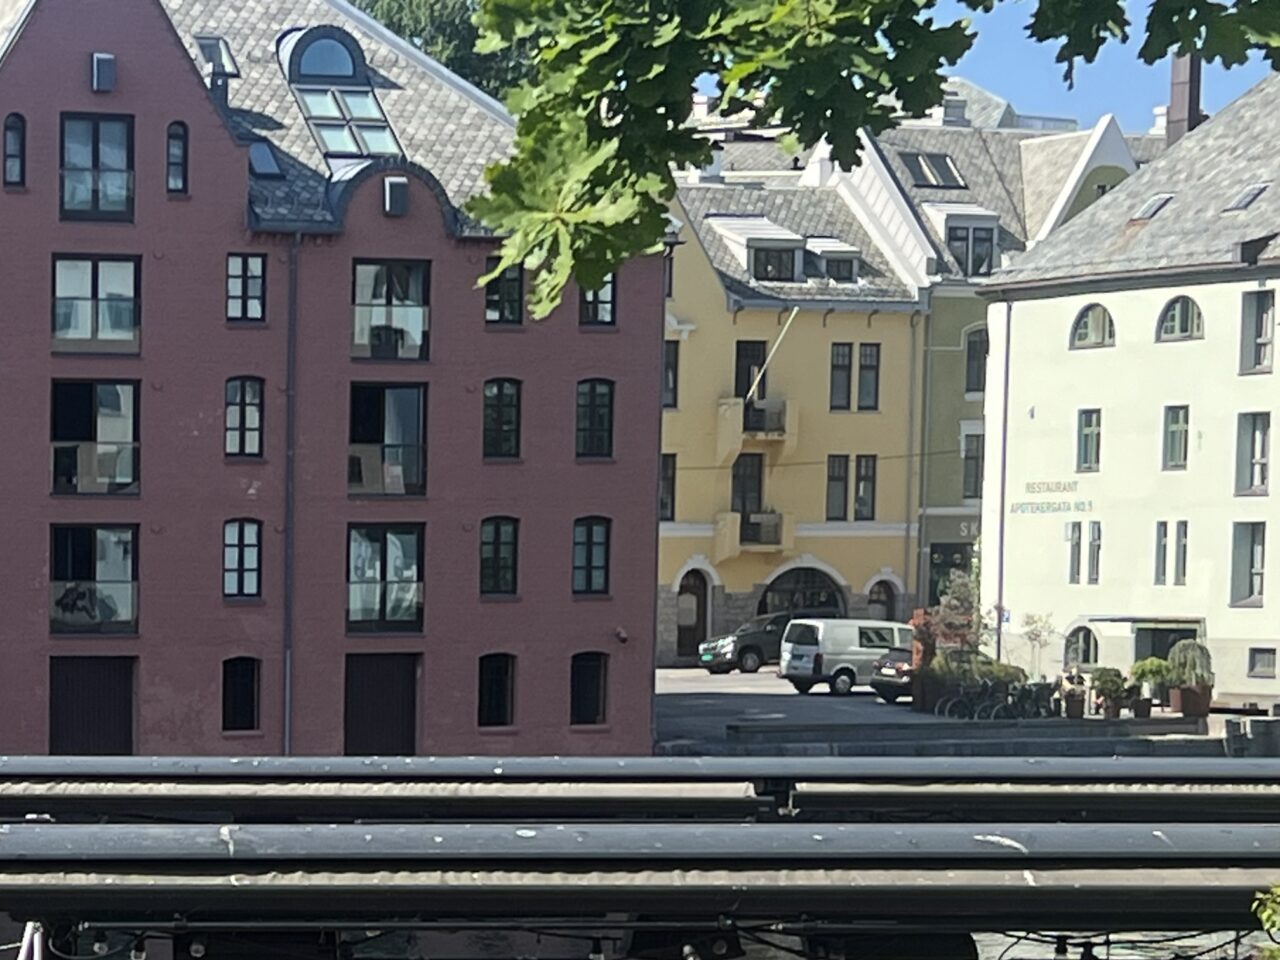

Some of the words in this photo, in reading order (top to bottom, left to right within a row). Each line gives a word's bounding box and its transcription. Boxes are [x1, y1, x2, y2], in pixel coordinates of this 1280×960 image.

[1025, 481, 1078, 494] RESTAURANT
[1010, 501, 1071, 514] APOTEKERGATA
[960, 521, 980, 536] SK
